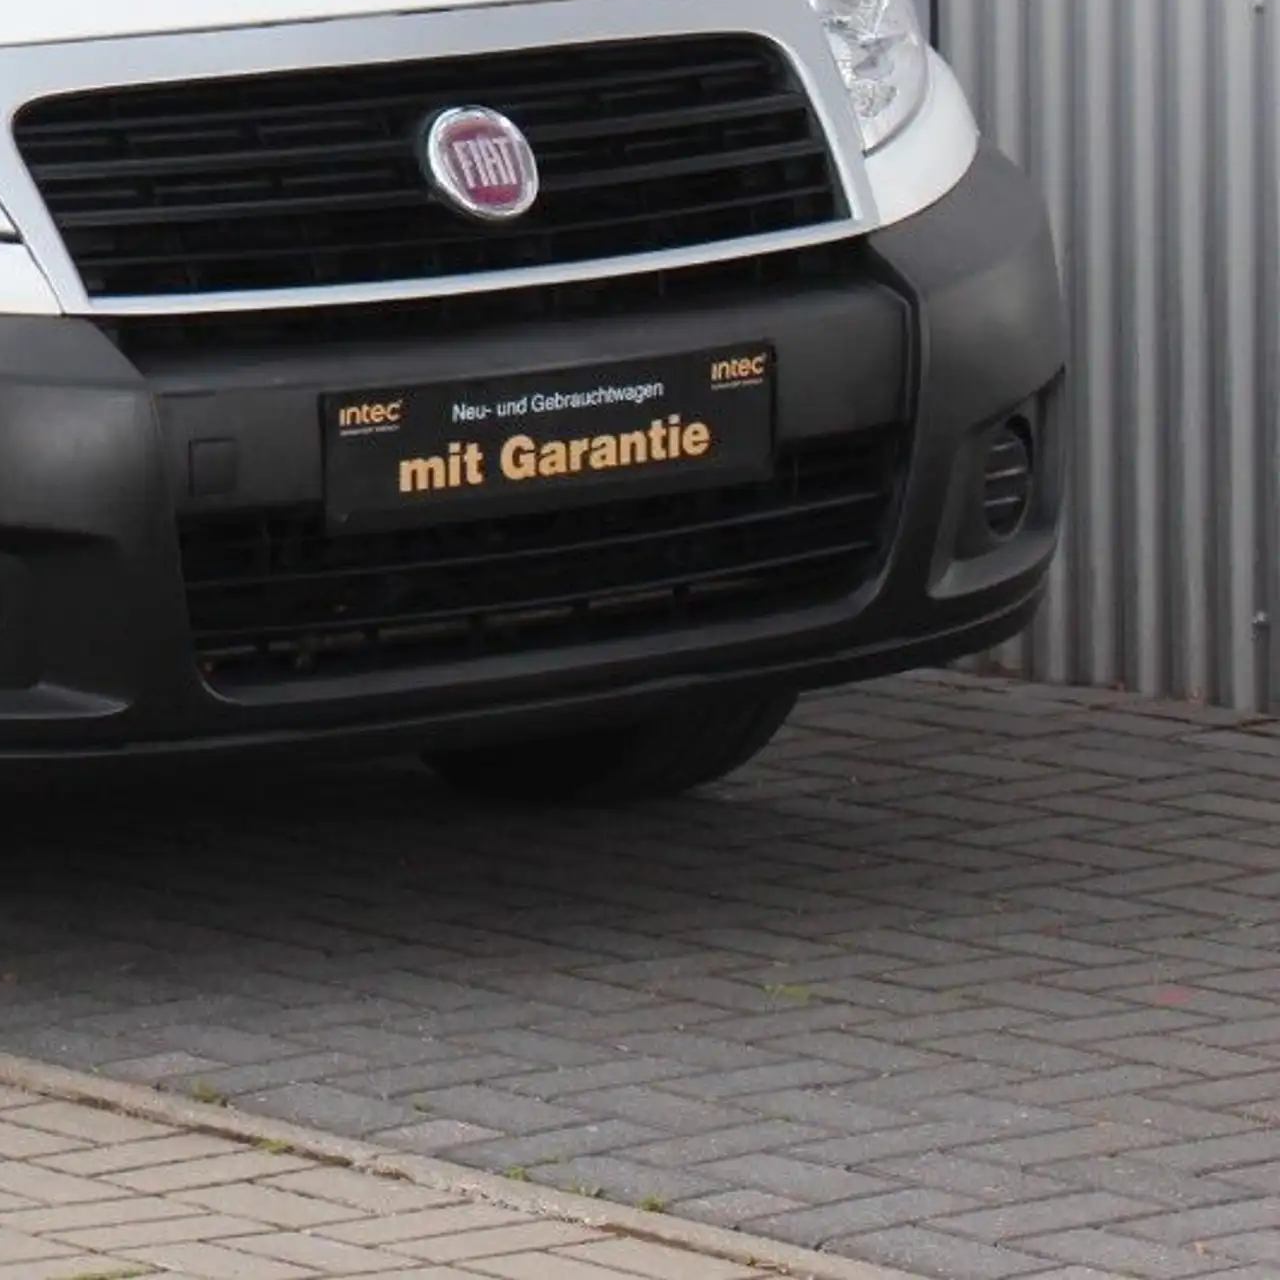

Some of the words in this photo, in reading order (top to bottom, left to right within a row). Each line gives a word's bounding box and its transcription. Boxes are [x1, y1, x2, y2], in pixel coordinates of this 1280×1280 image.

[451, 135, 518, 189] FIAT
[452, 404, 492, 422] Neu-
[497, 396, 528, 418] und
[531, 381, 665, 413] Gebrauchtwagen
[398, 441, 484, 492] mit
[500, 414, 712, 481] Garantie
